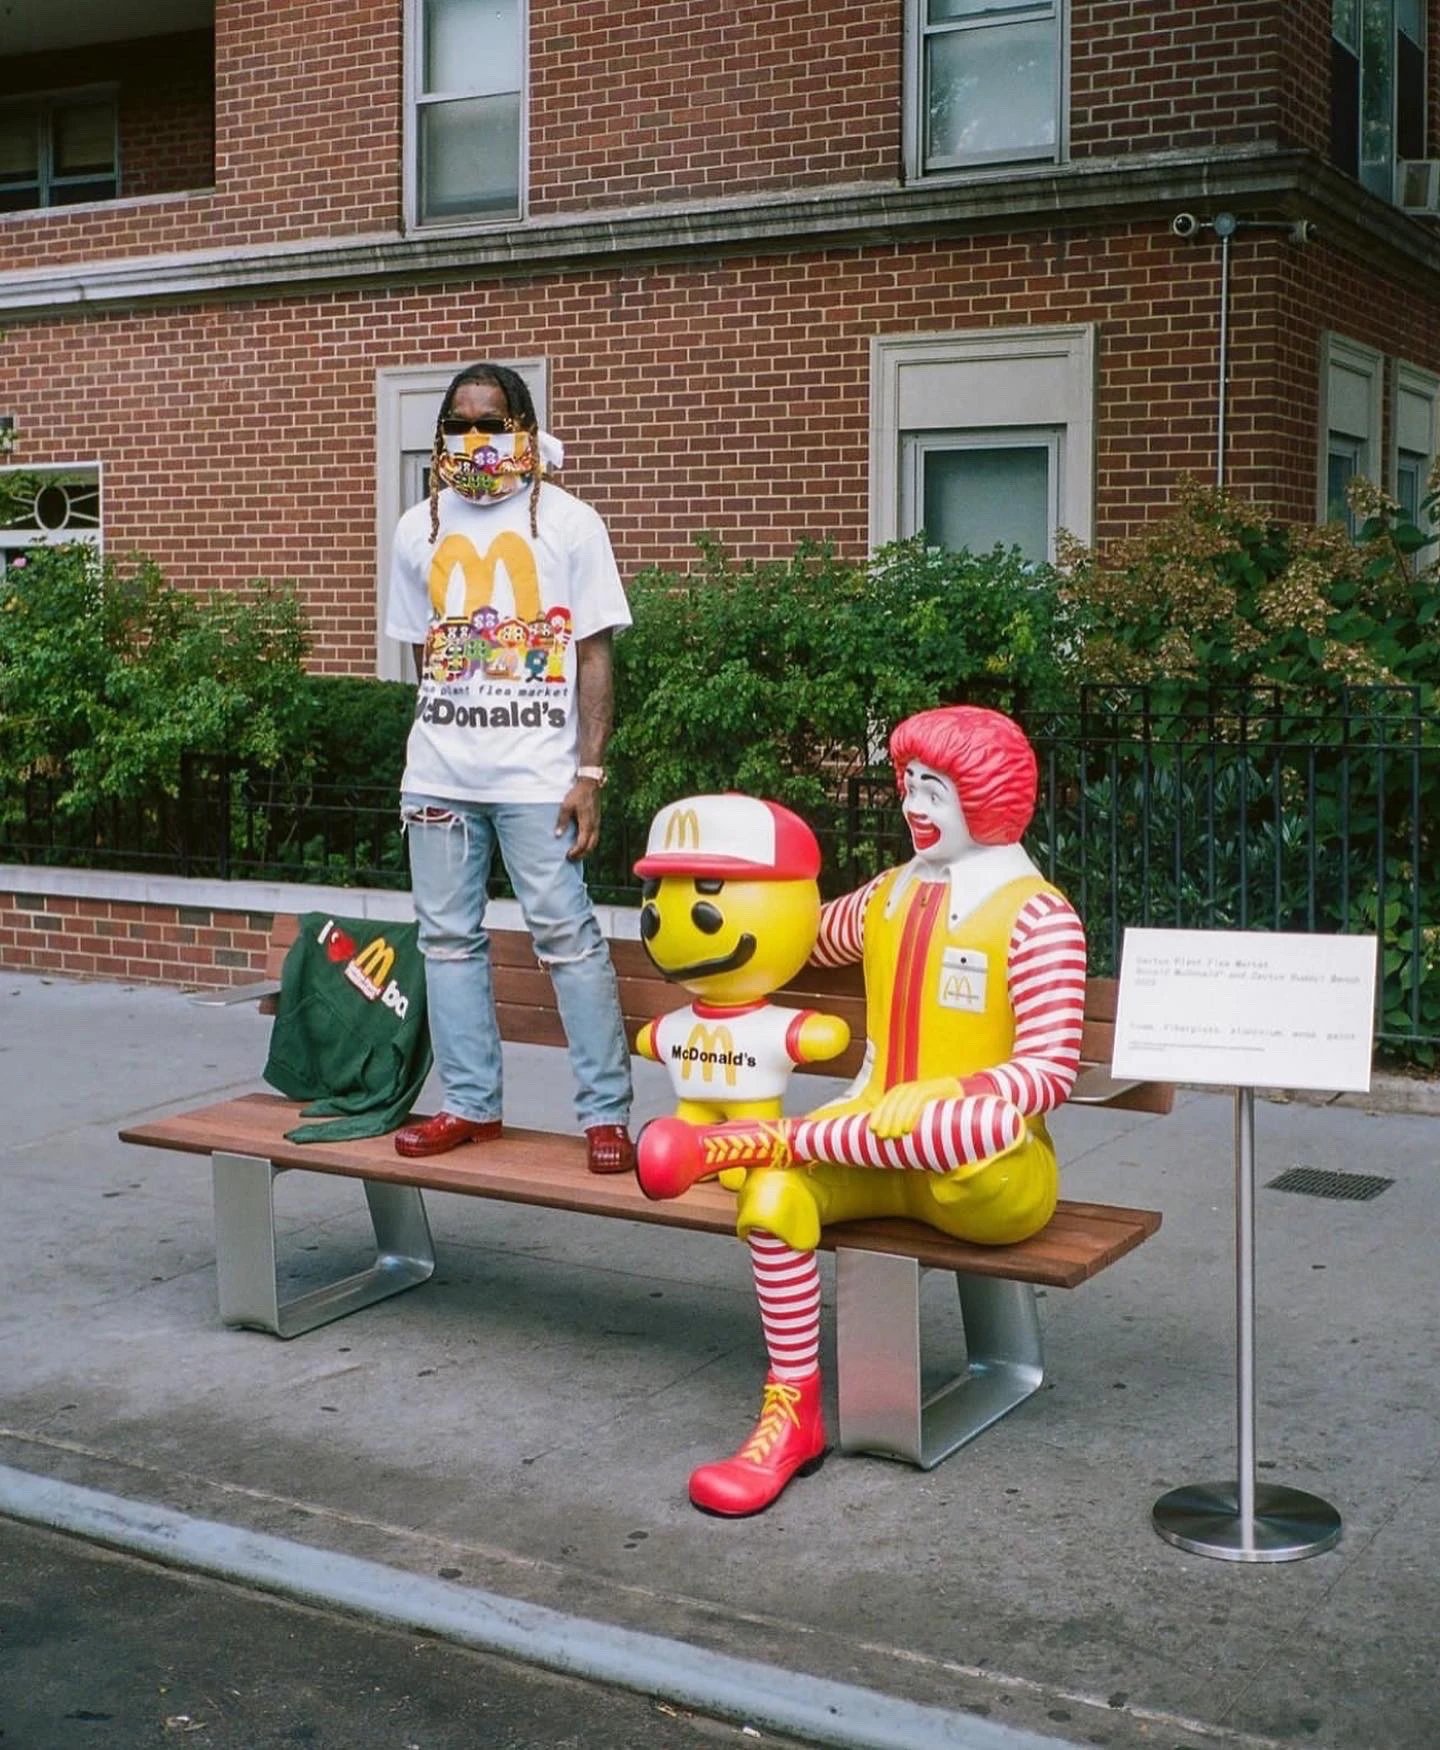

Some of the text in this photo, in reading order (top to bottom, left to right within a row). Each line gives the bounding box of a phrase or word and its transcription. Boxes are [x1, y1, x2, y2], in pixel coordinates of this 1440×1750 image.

[479, 686, 511, 697] flea
[518, 686, 569, 698] market
[671, 1045, 757, 1068] McDonald's
